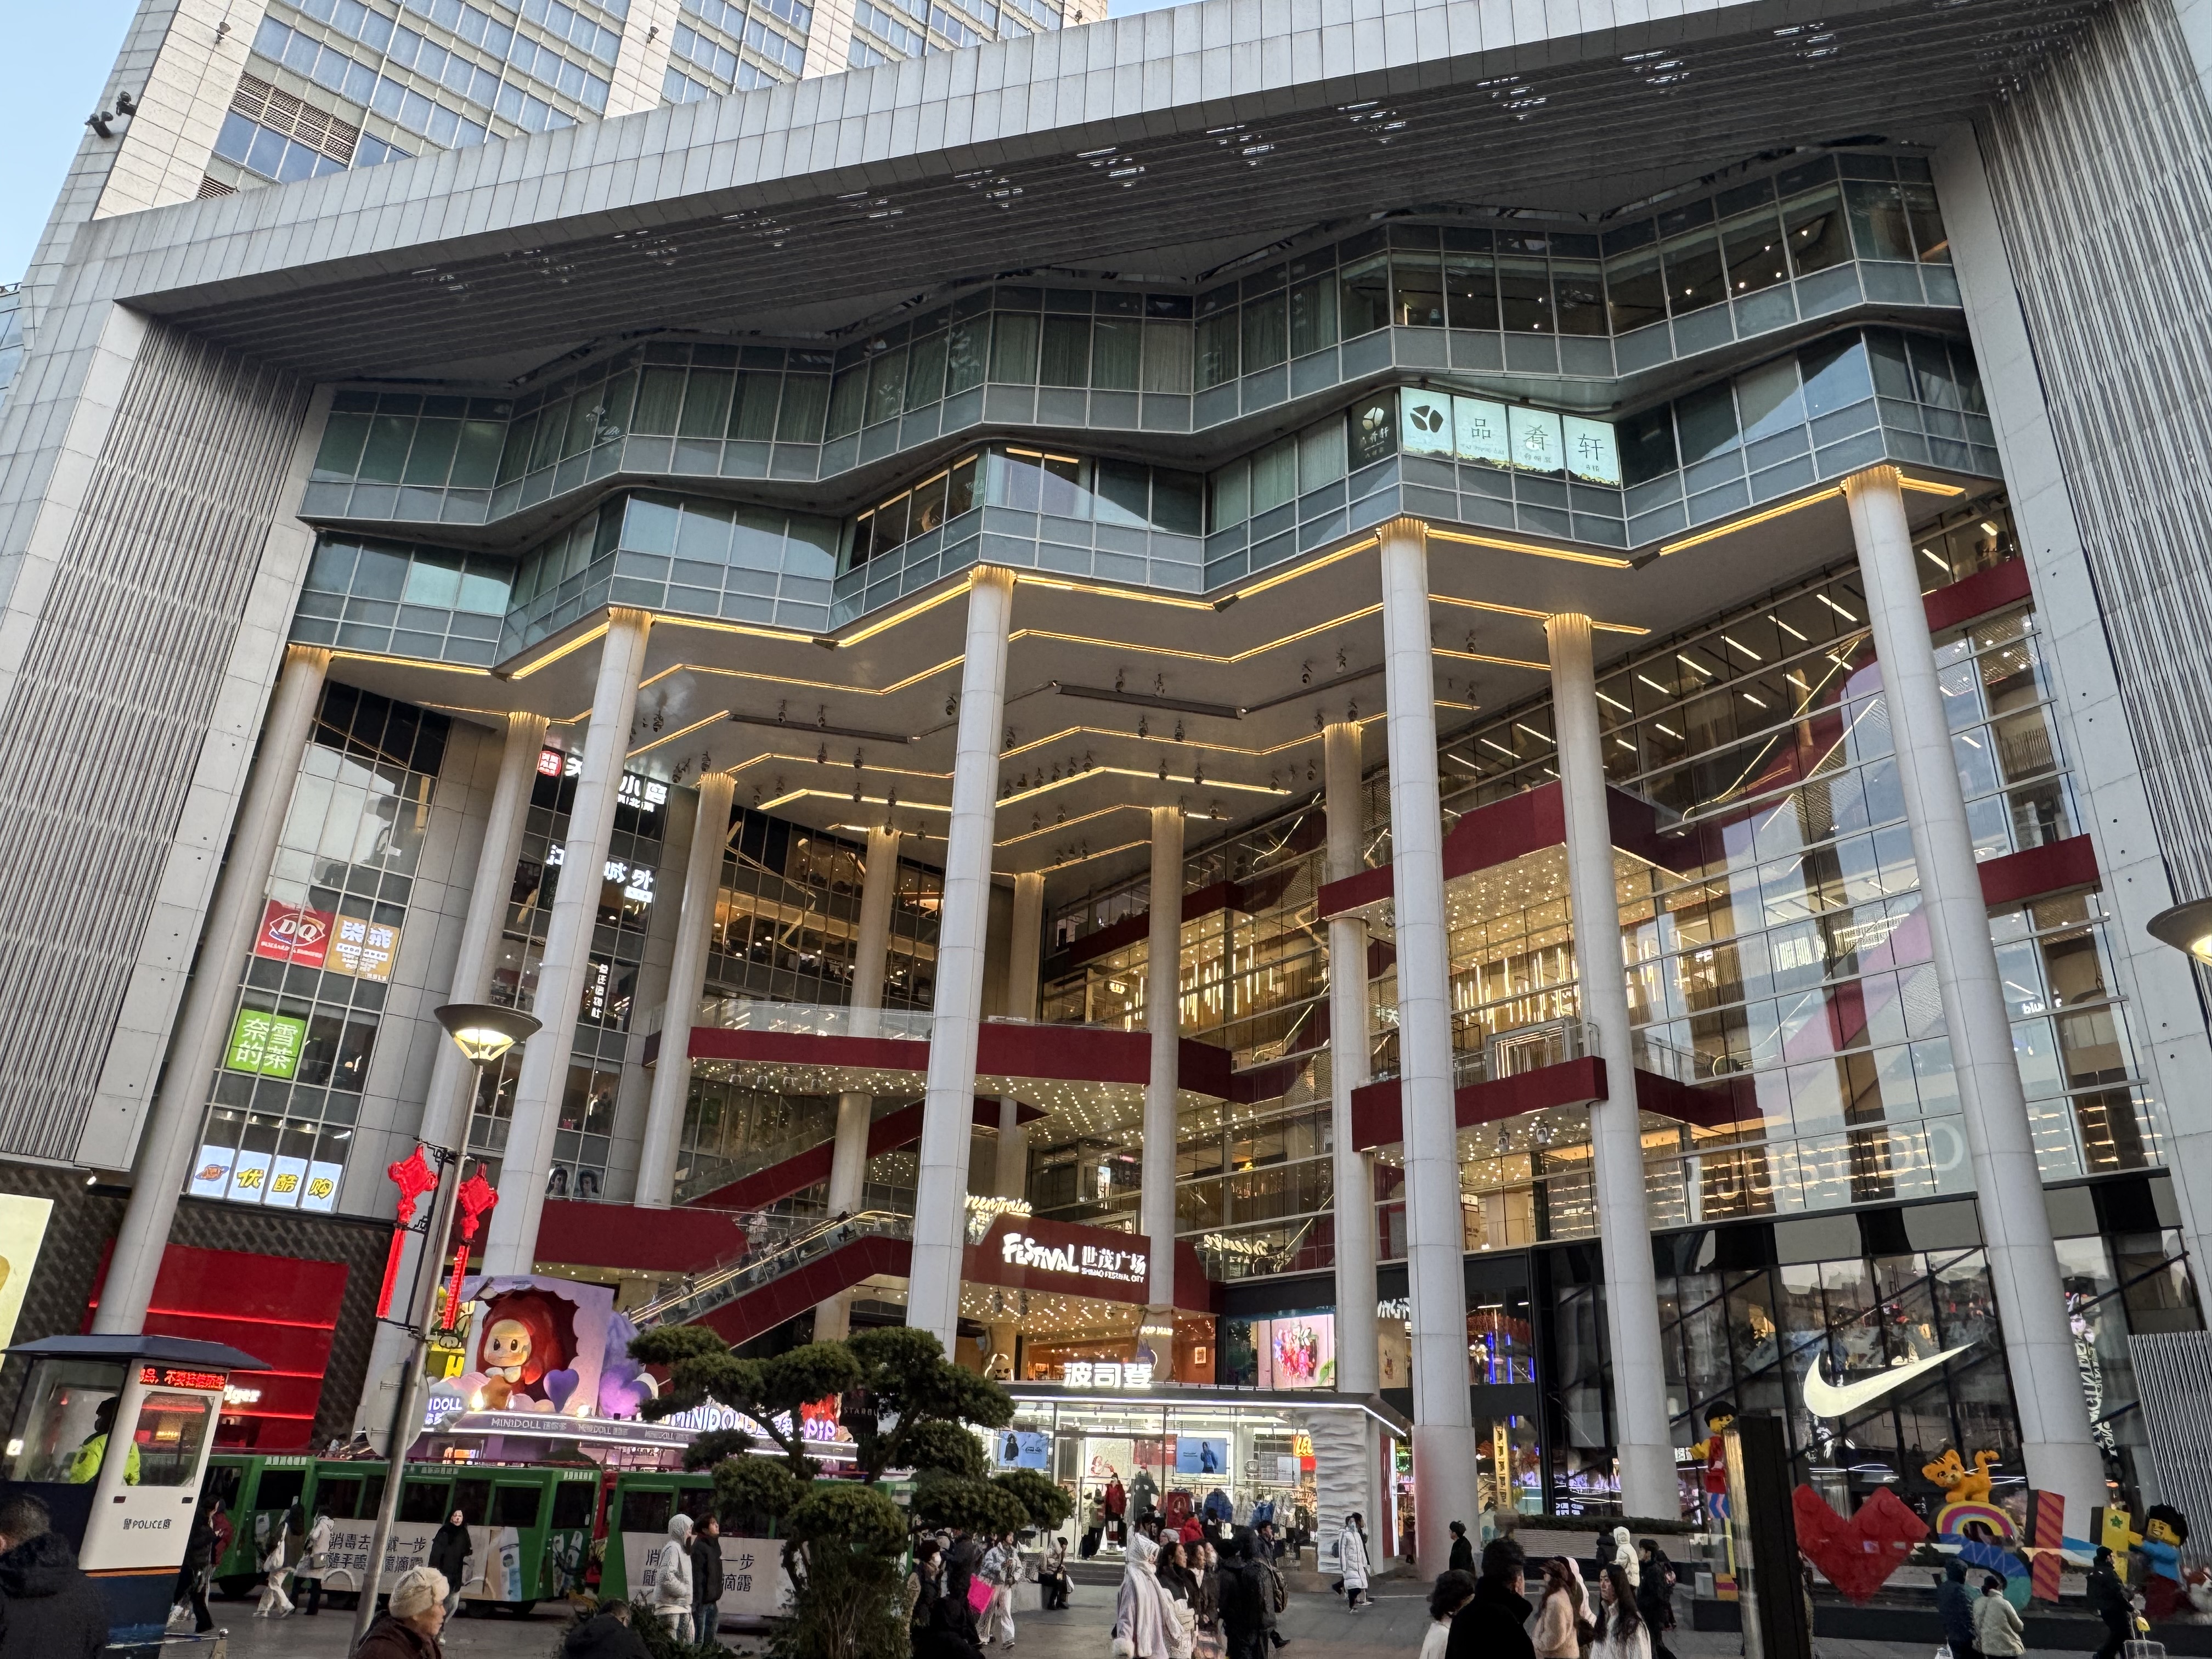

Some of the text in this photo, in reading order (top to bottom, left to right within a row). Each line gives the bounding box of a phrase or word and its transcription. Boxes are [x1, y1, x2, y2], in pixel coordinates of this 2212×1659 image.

[1471, 418, 1604, 461] 品肴轩
[278, 919, 317, 942] DQ
[242, 1018, 298, 1048] 奈雪
[235, 1040, 292, 1070] 的茶
[236, 1167, 334, 1199] 优酷购
[1081, 1245, 1146, 1275] 世茂广场
[1063, 1362, 1154, 1390] 波司登
